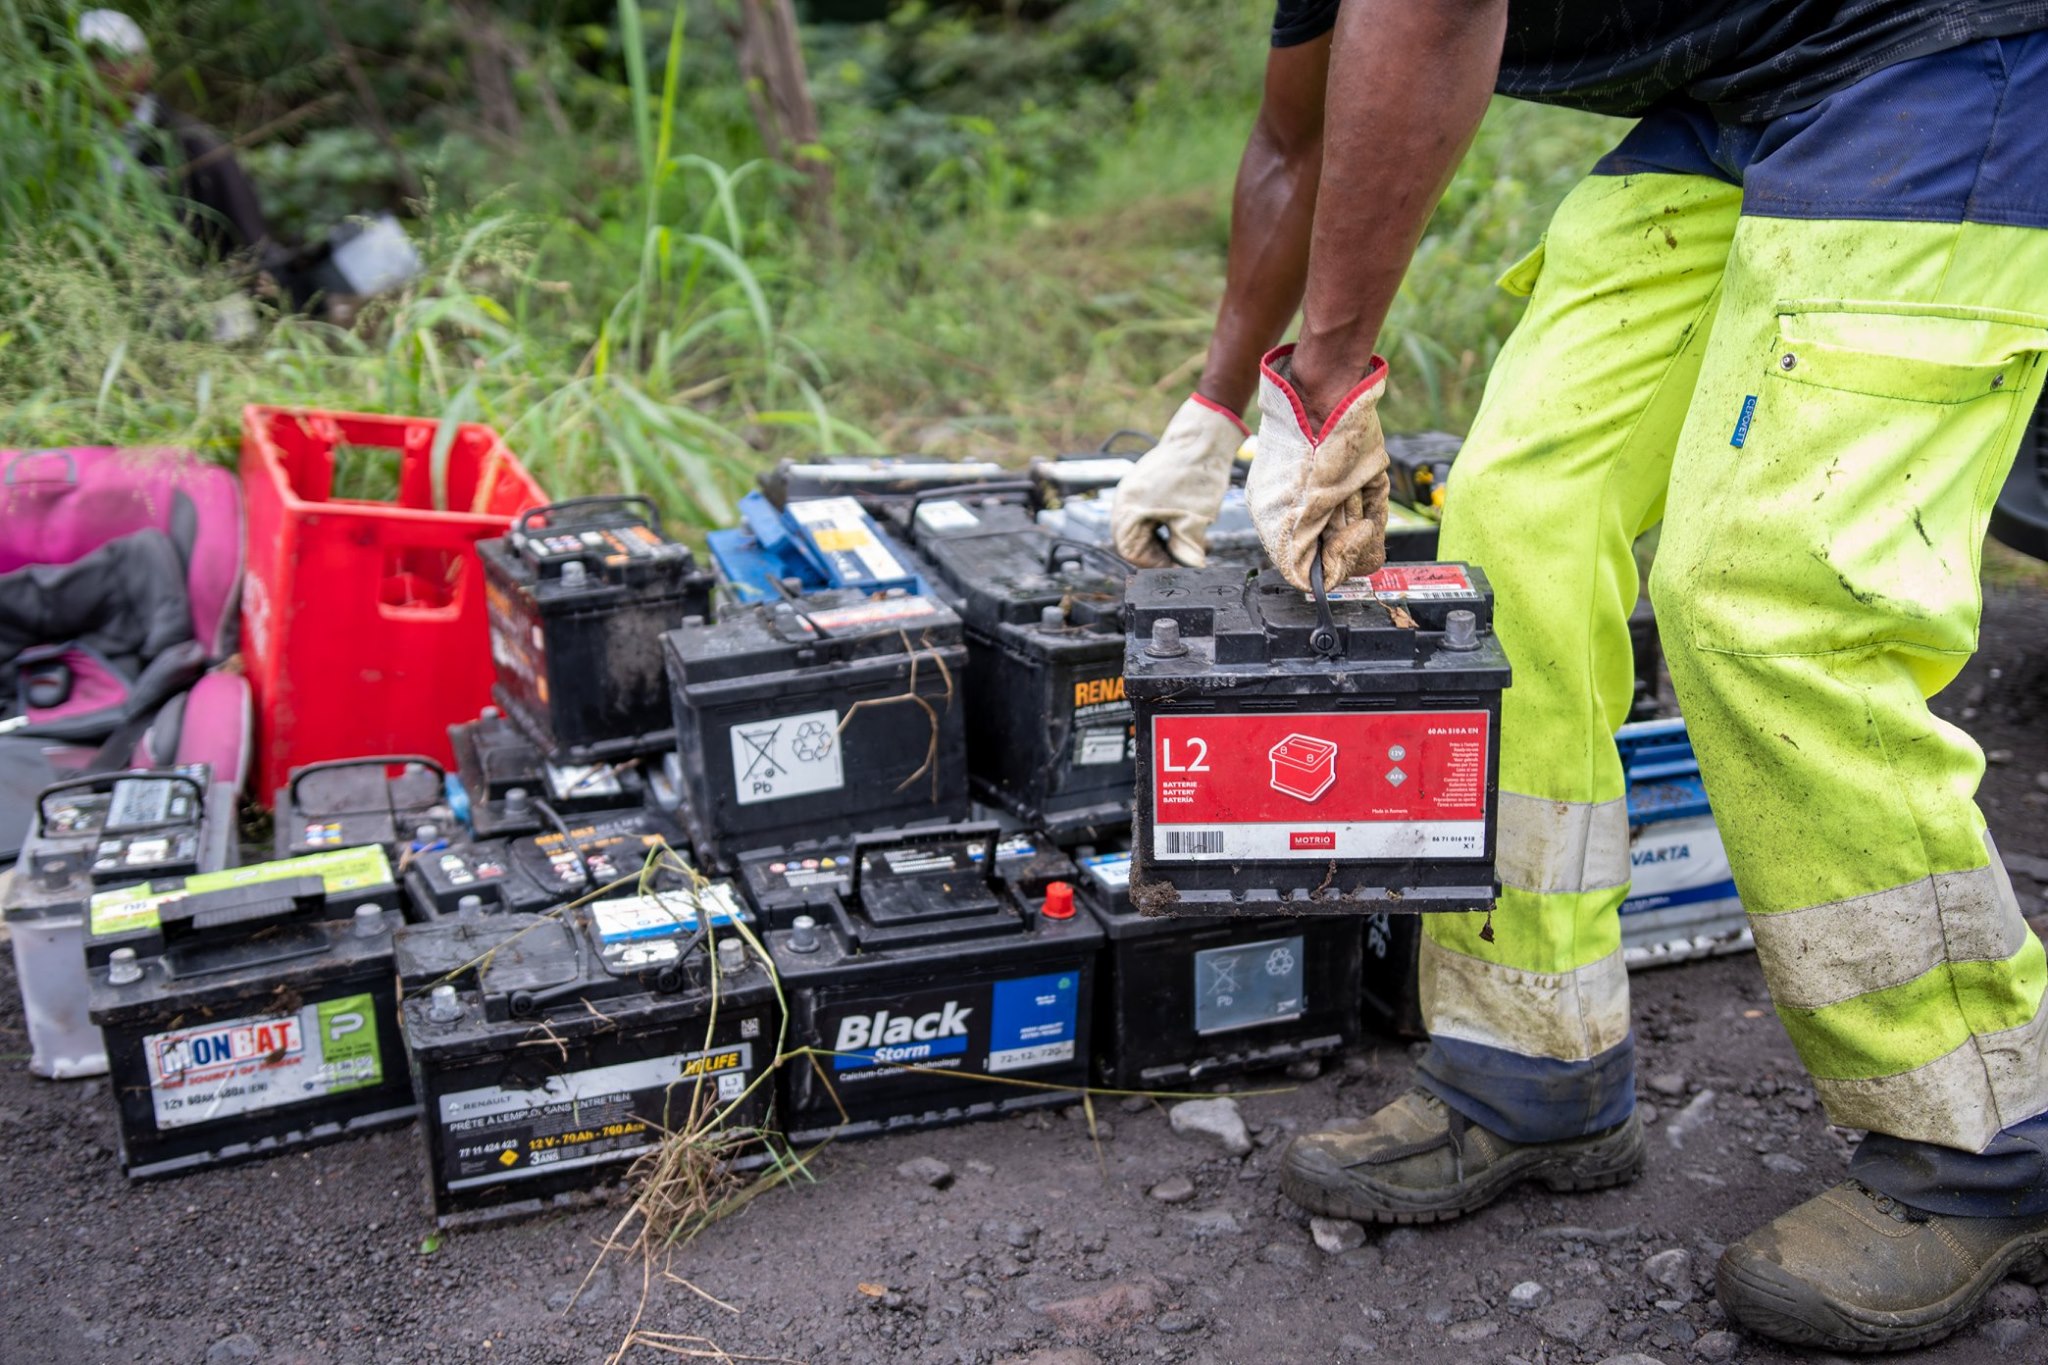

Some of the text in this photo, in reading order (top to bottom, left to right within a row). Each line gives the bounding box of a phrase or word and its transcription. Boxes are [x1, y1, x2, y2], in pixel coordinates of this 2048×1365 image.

[1074, 676, 1127, 707] RENA
[1163, 737, 1210, 772] L2
[752, 781, 772, 795] Pb
[1294, 836, 1331, 844] MOTRIO
[1631, 845, 1690, 867] VARTA
[834, 1000, 974, 1051] Black
[160, 1021, 292, 1074] MONBAT
[872, 1043, 931, 1063] Storm
[463, 1095, 512, 1111] RENAULT
[529, 1150, 540, 1165] 3
